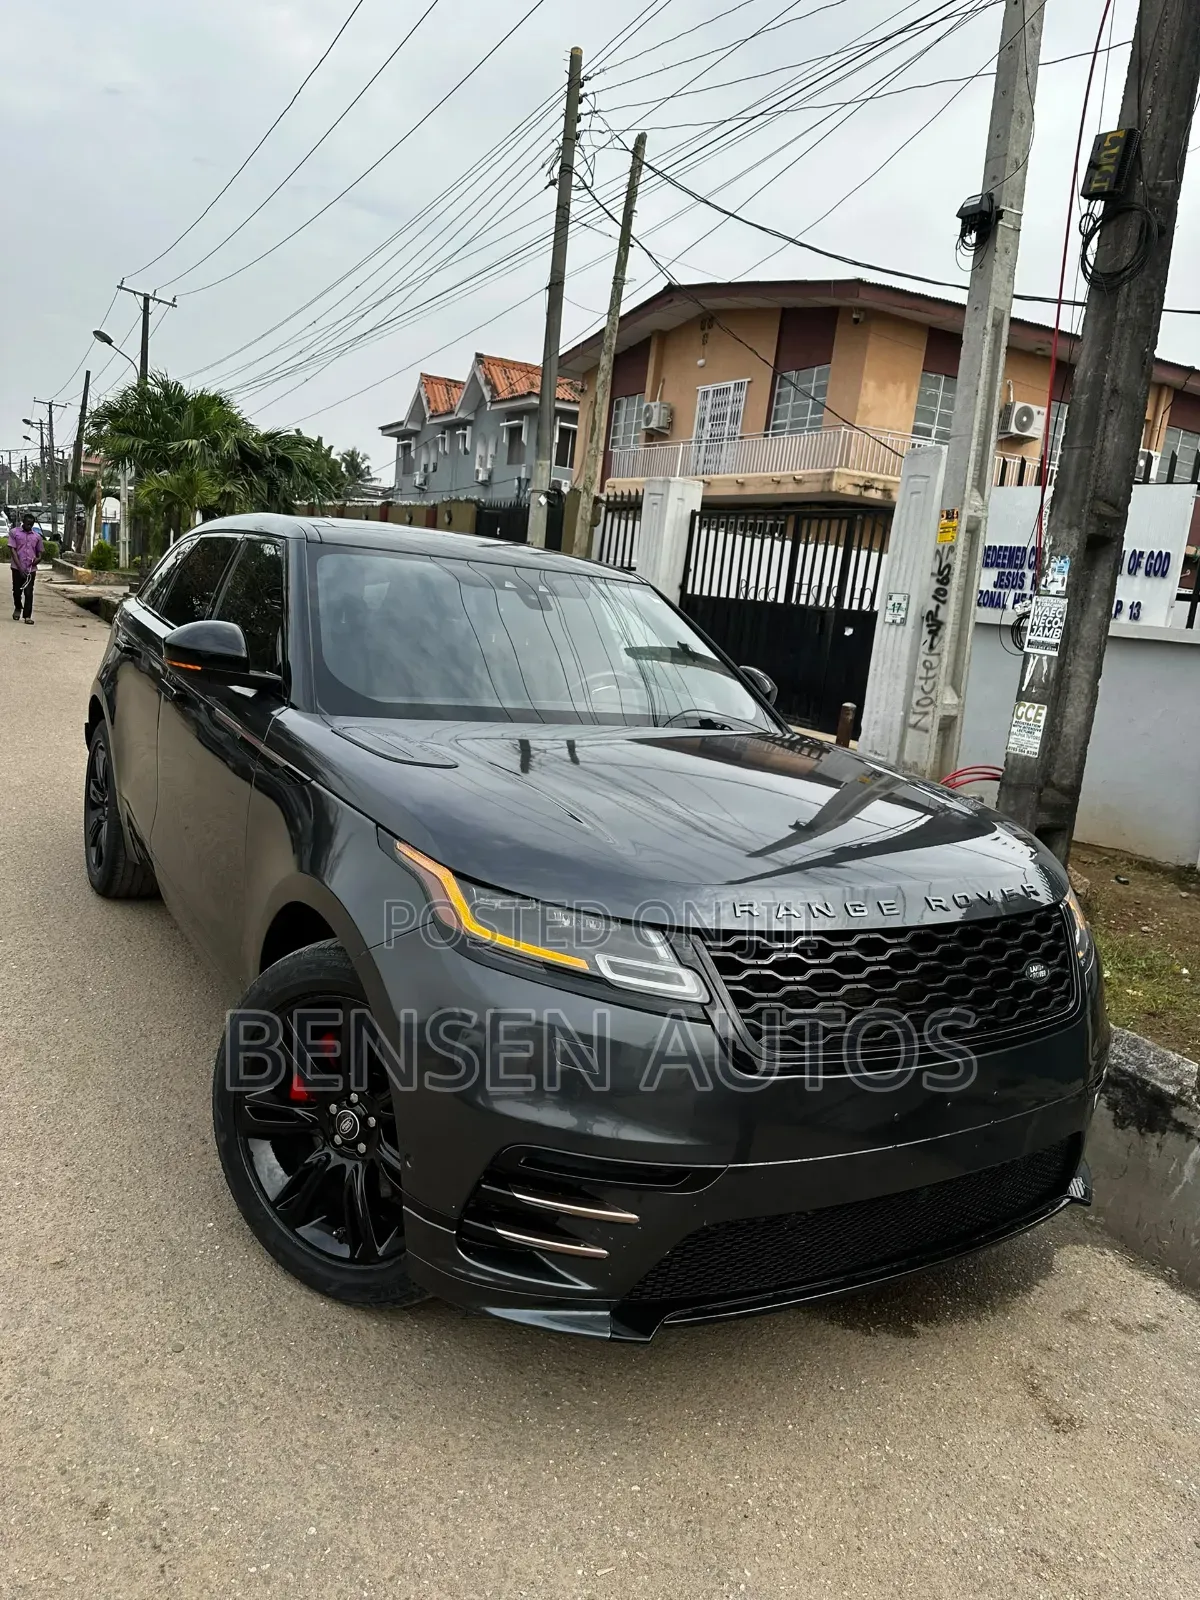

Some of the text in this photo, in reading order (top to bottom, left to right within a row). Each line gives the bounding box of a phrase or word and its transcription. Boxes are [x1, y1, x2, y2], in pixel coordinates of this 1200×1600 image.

[1127, 549, 1145, 576] OF
[1145, 550, 1171, 578] GOD
[993, 571, 1026, 590] JESUS
[892, 602, 902, 613] 17
[977, 590, 1007, 610] ZONAL
[1129, 601, 1142, 621] 13
[1034, 605, 1064, 618] WAEC
[1030, 626, 1061, 639] JAMB
[1015, 702, 1046, 724] GCE
[733, 882, 1041, 919] RANGE ROVER
